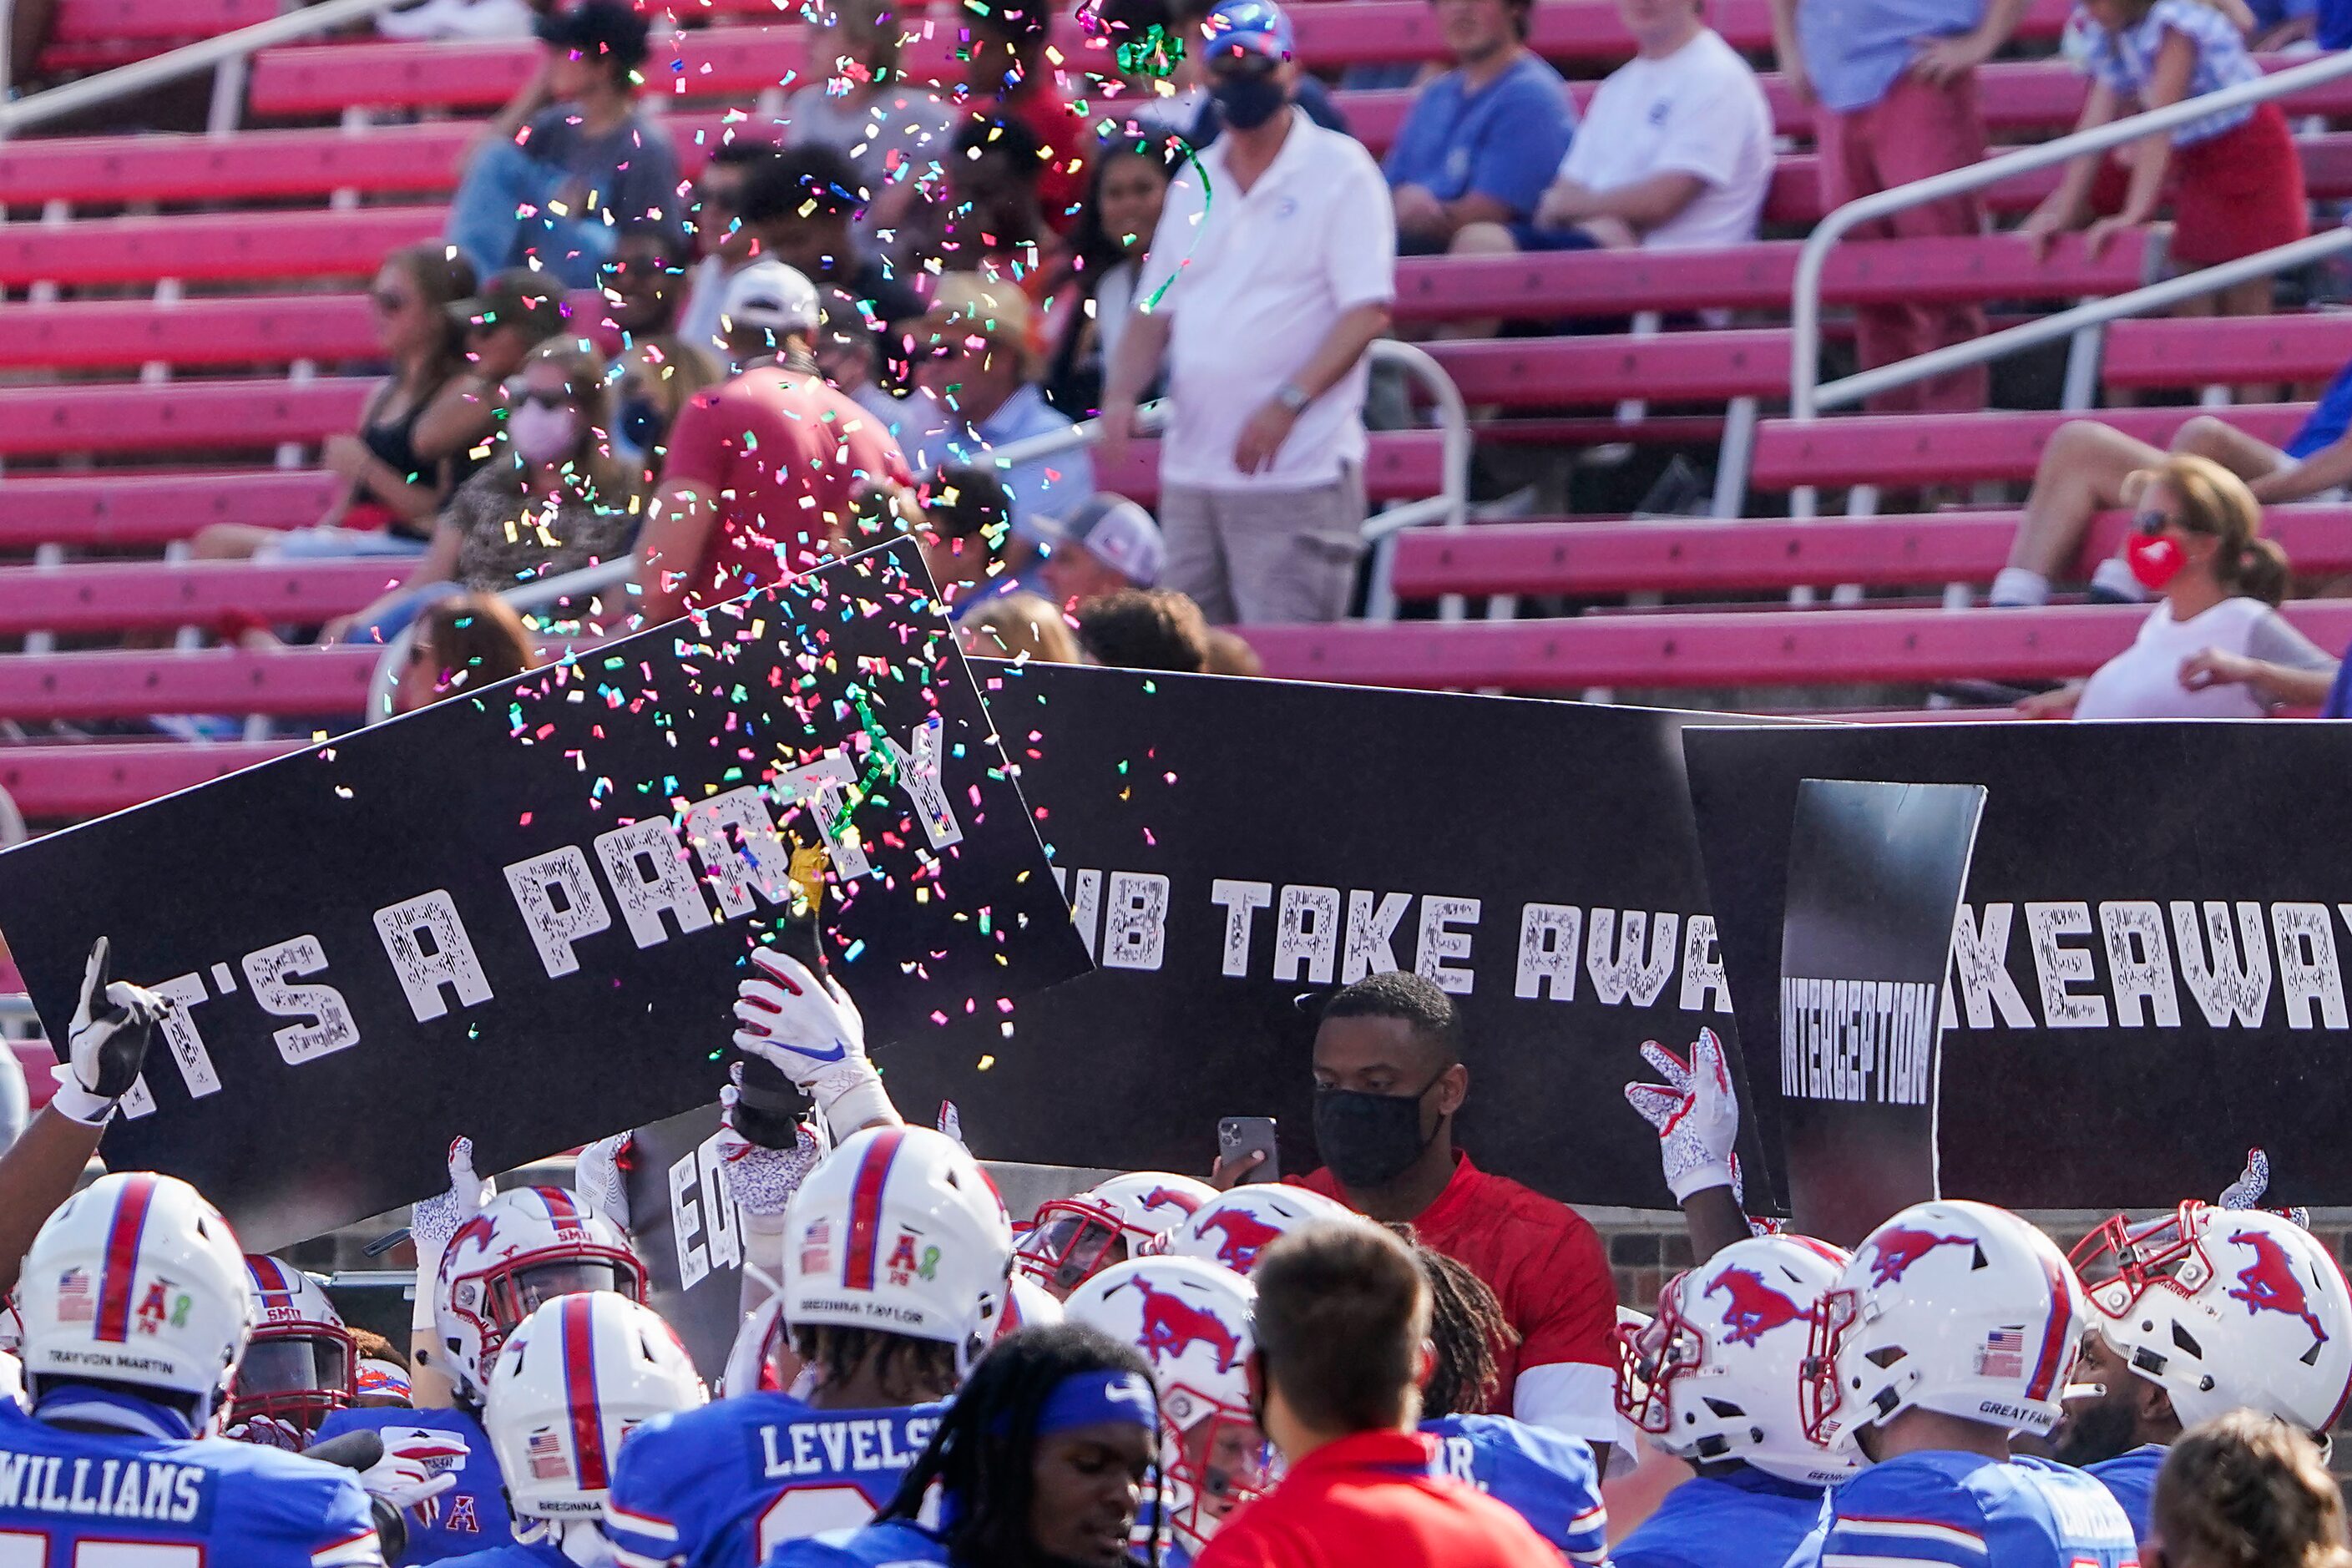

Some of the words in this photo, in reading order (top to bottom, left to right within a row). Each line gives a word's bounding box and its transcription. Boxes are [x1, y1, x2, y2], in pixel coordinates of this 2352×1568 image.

[119, 934, 361, 1120] T'S
[372, 888, 494, 1022] A
[503, 717, 964, 979] PARTY
[1211, 879, 1482, 995] TAKE
[1941, 901, 2352, 1029] KEAWA
[1781, 977, 1936, 1105] INTERCEPTION
[267, 1308, 301, 1321] SMU
[116, 1354, 175, 1375] MARTIN
[1979, 1400, 2030, 1420] GREAT
[0, 1449, 206, 1523] WILLIAMS
